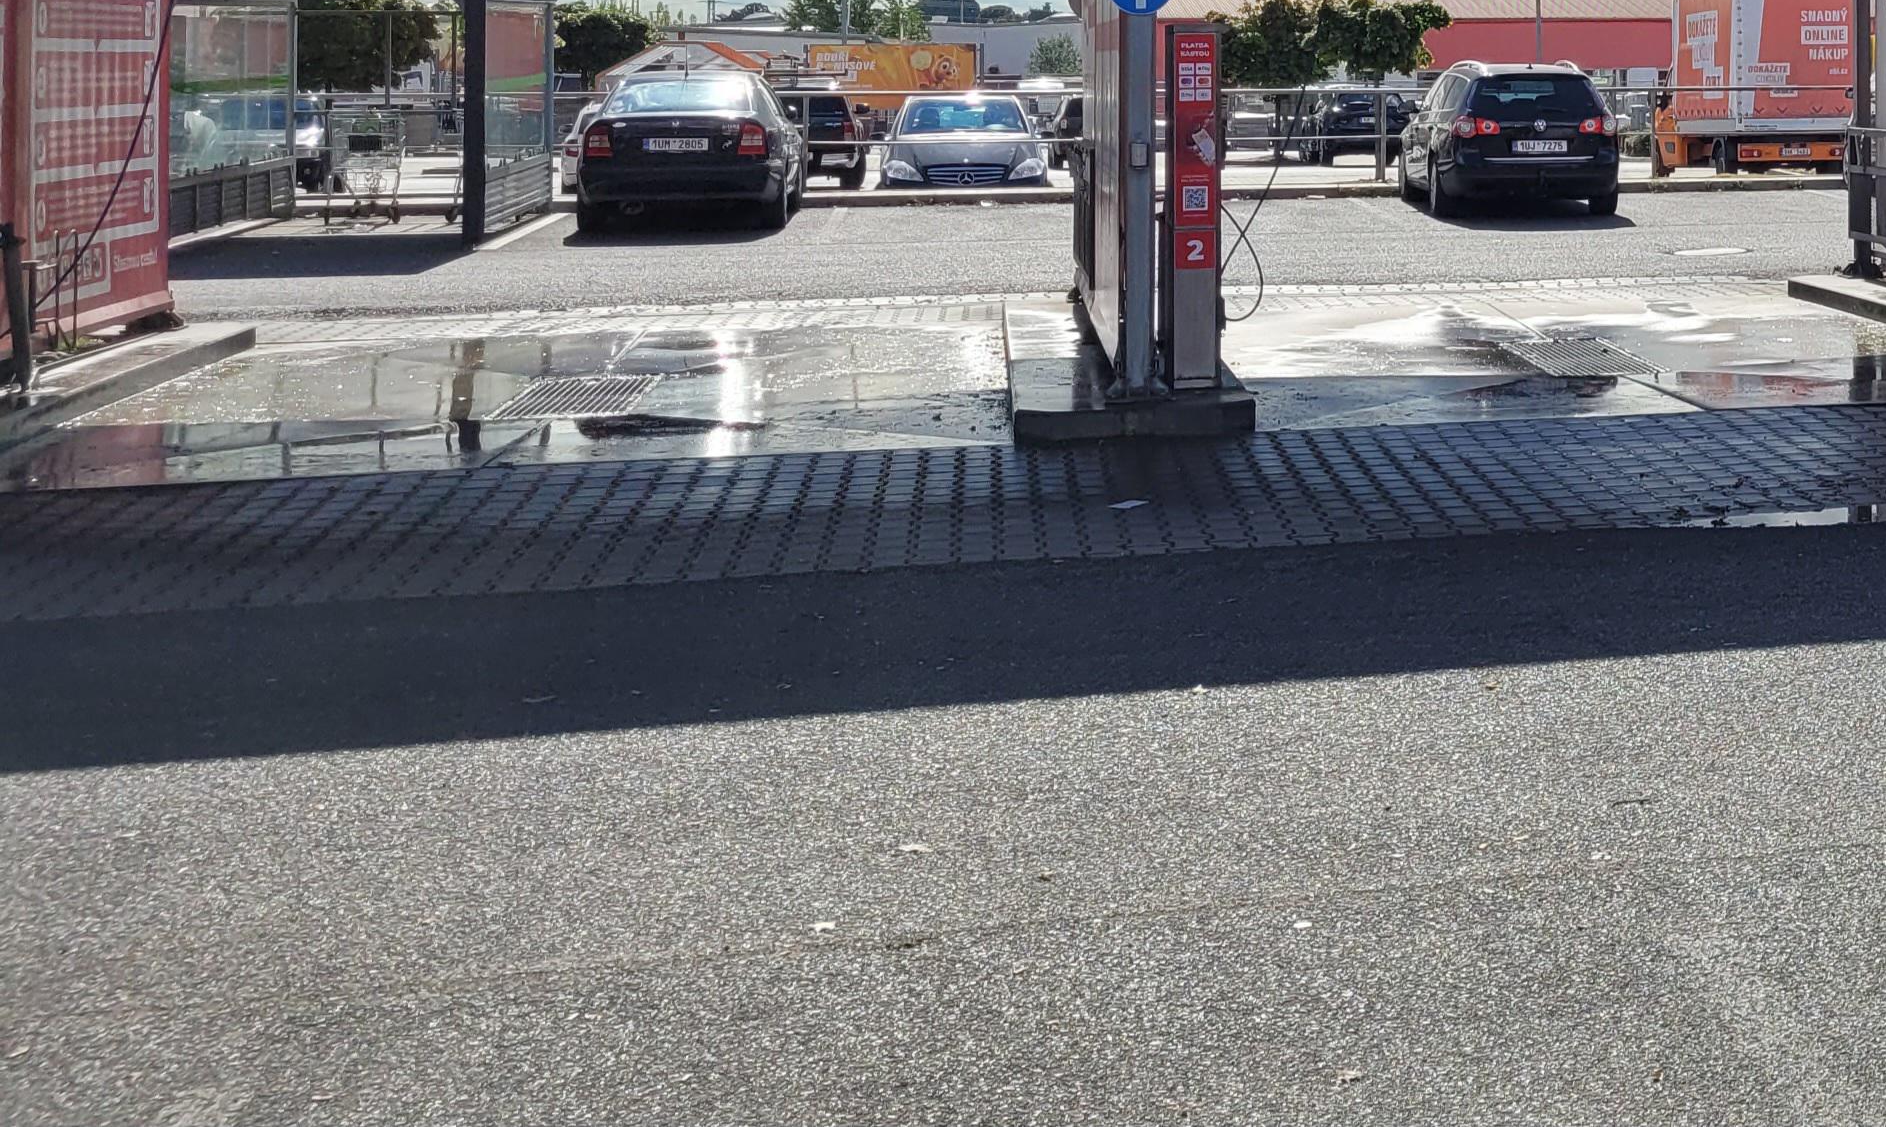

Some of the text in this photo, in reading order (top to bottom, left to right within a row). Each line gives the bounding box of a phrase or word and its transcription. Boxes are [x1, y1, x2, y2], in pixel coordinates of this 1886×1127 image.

[1800, 7, 1848, 23] SNADNÝ
[1804, 29, 1845, 41] ONLINE
[1808, 46, 1848, 61] NÁKUP
[1748, 63, 1788, 74] DOKÁŽETE
[653, 139, 704, 149] 1UM 2805
[1520, 141, 1536, 150] 1UJ
[1186, 239, 1205, 261] 2
